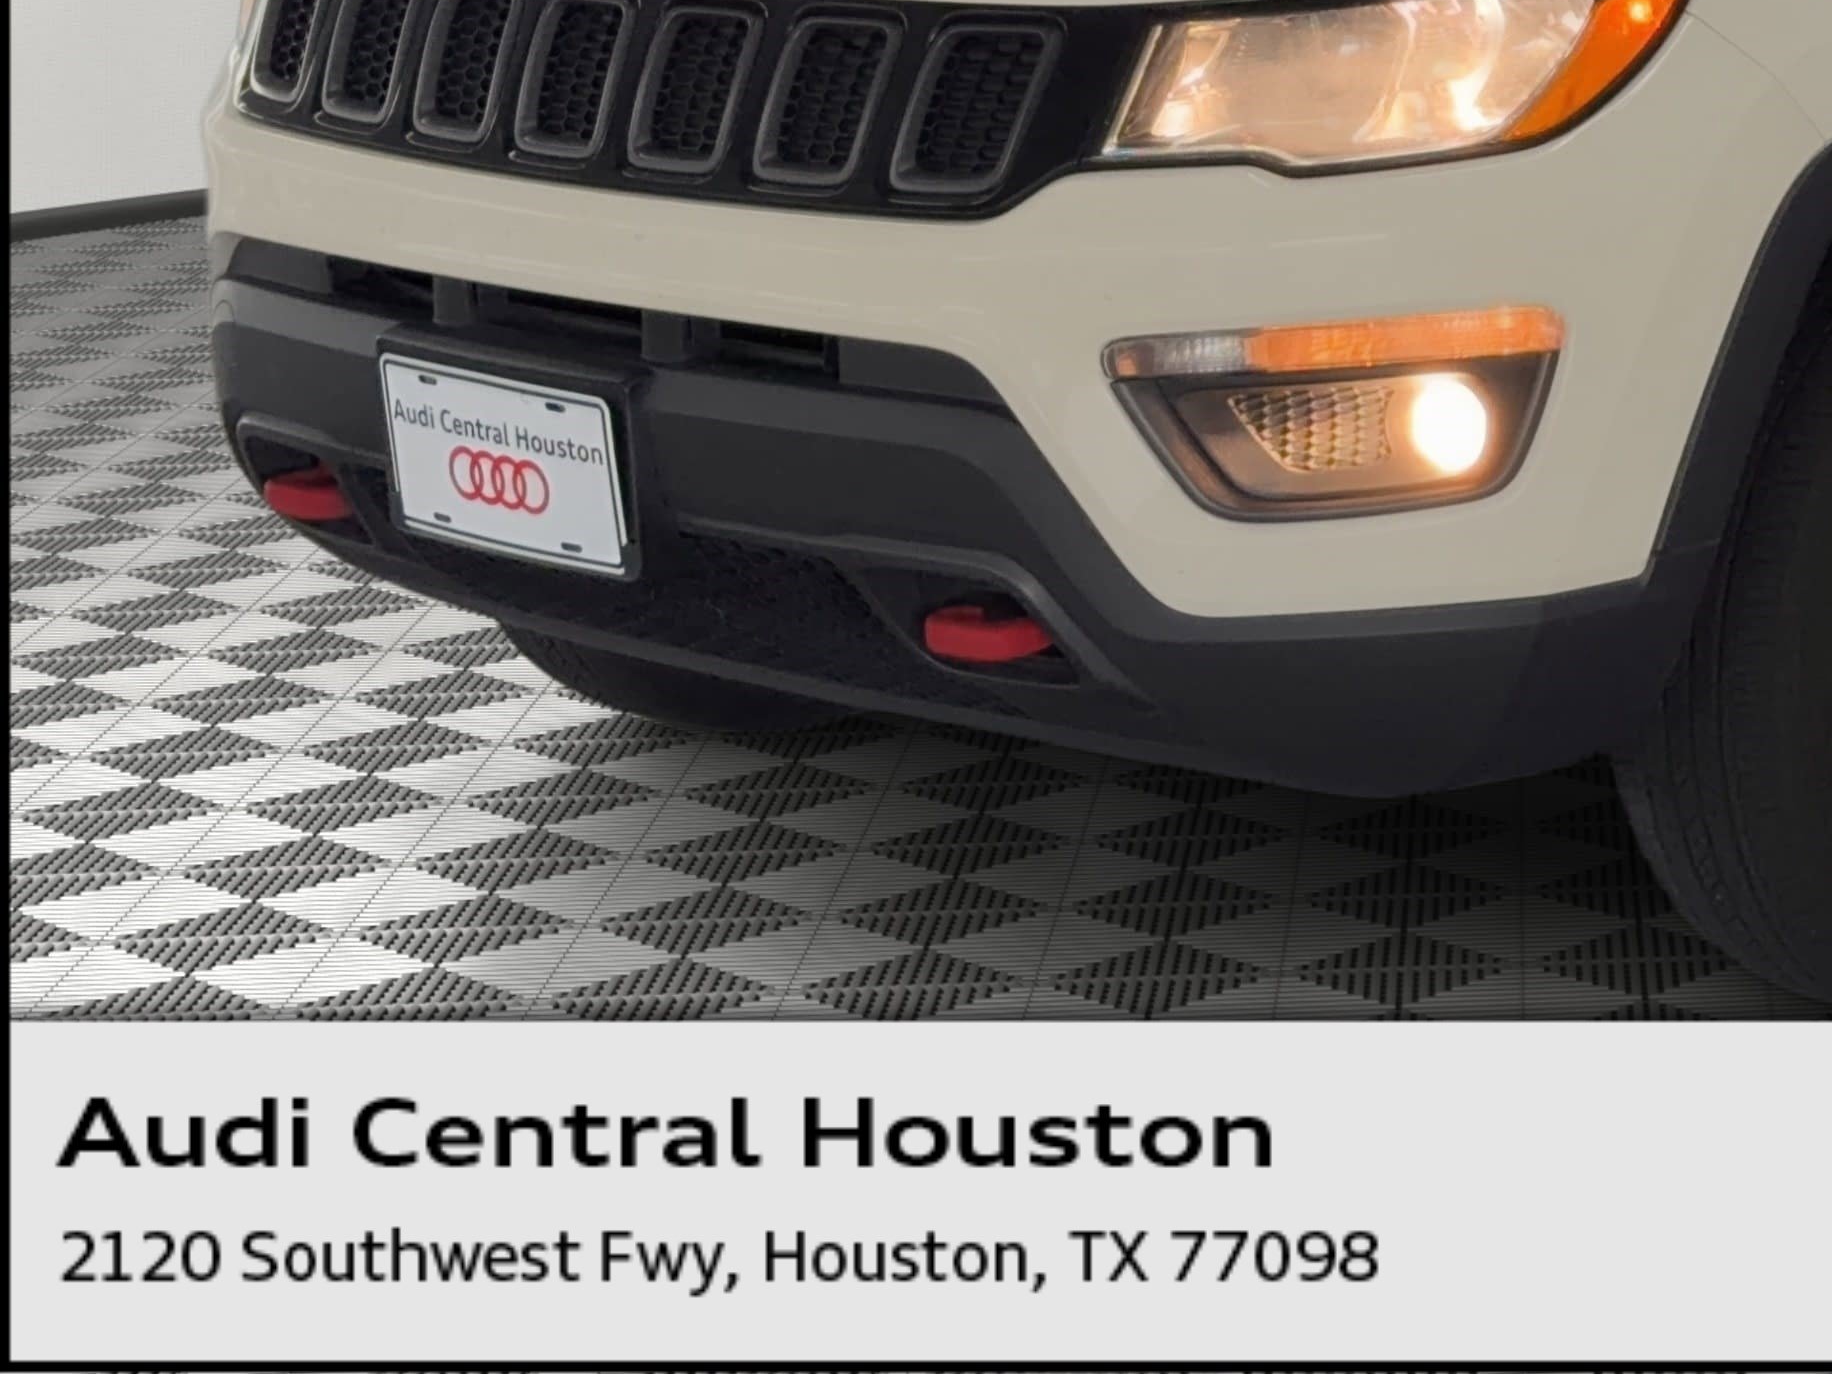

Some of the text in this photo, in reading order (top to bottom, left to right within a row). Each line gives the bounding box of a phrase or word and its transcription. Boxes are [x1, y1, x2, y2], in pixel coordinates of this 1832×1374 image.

[394, 398, 604, 466] Audi Central Houston
